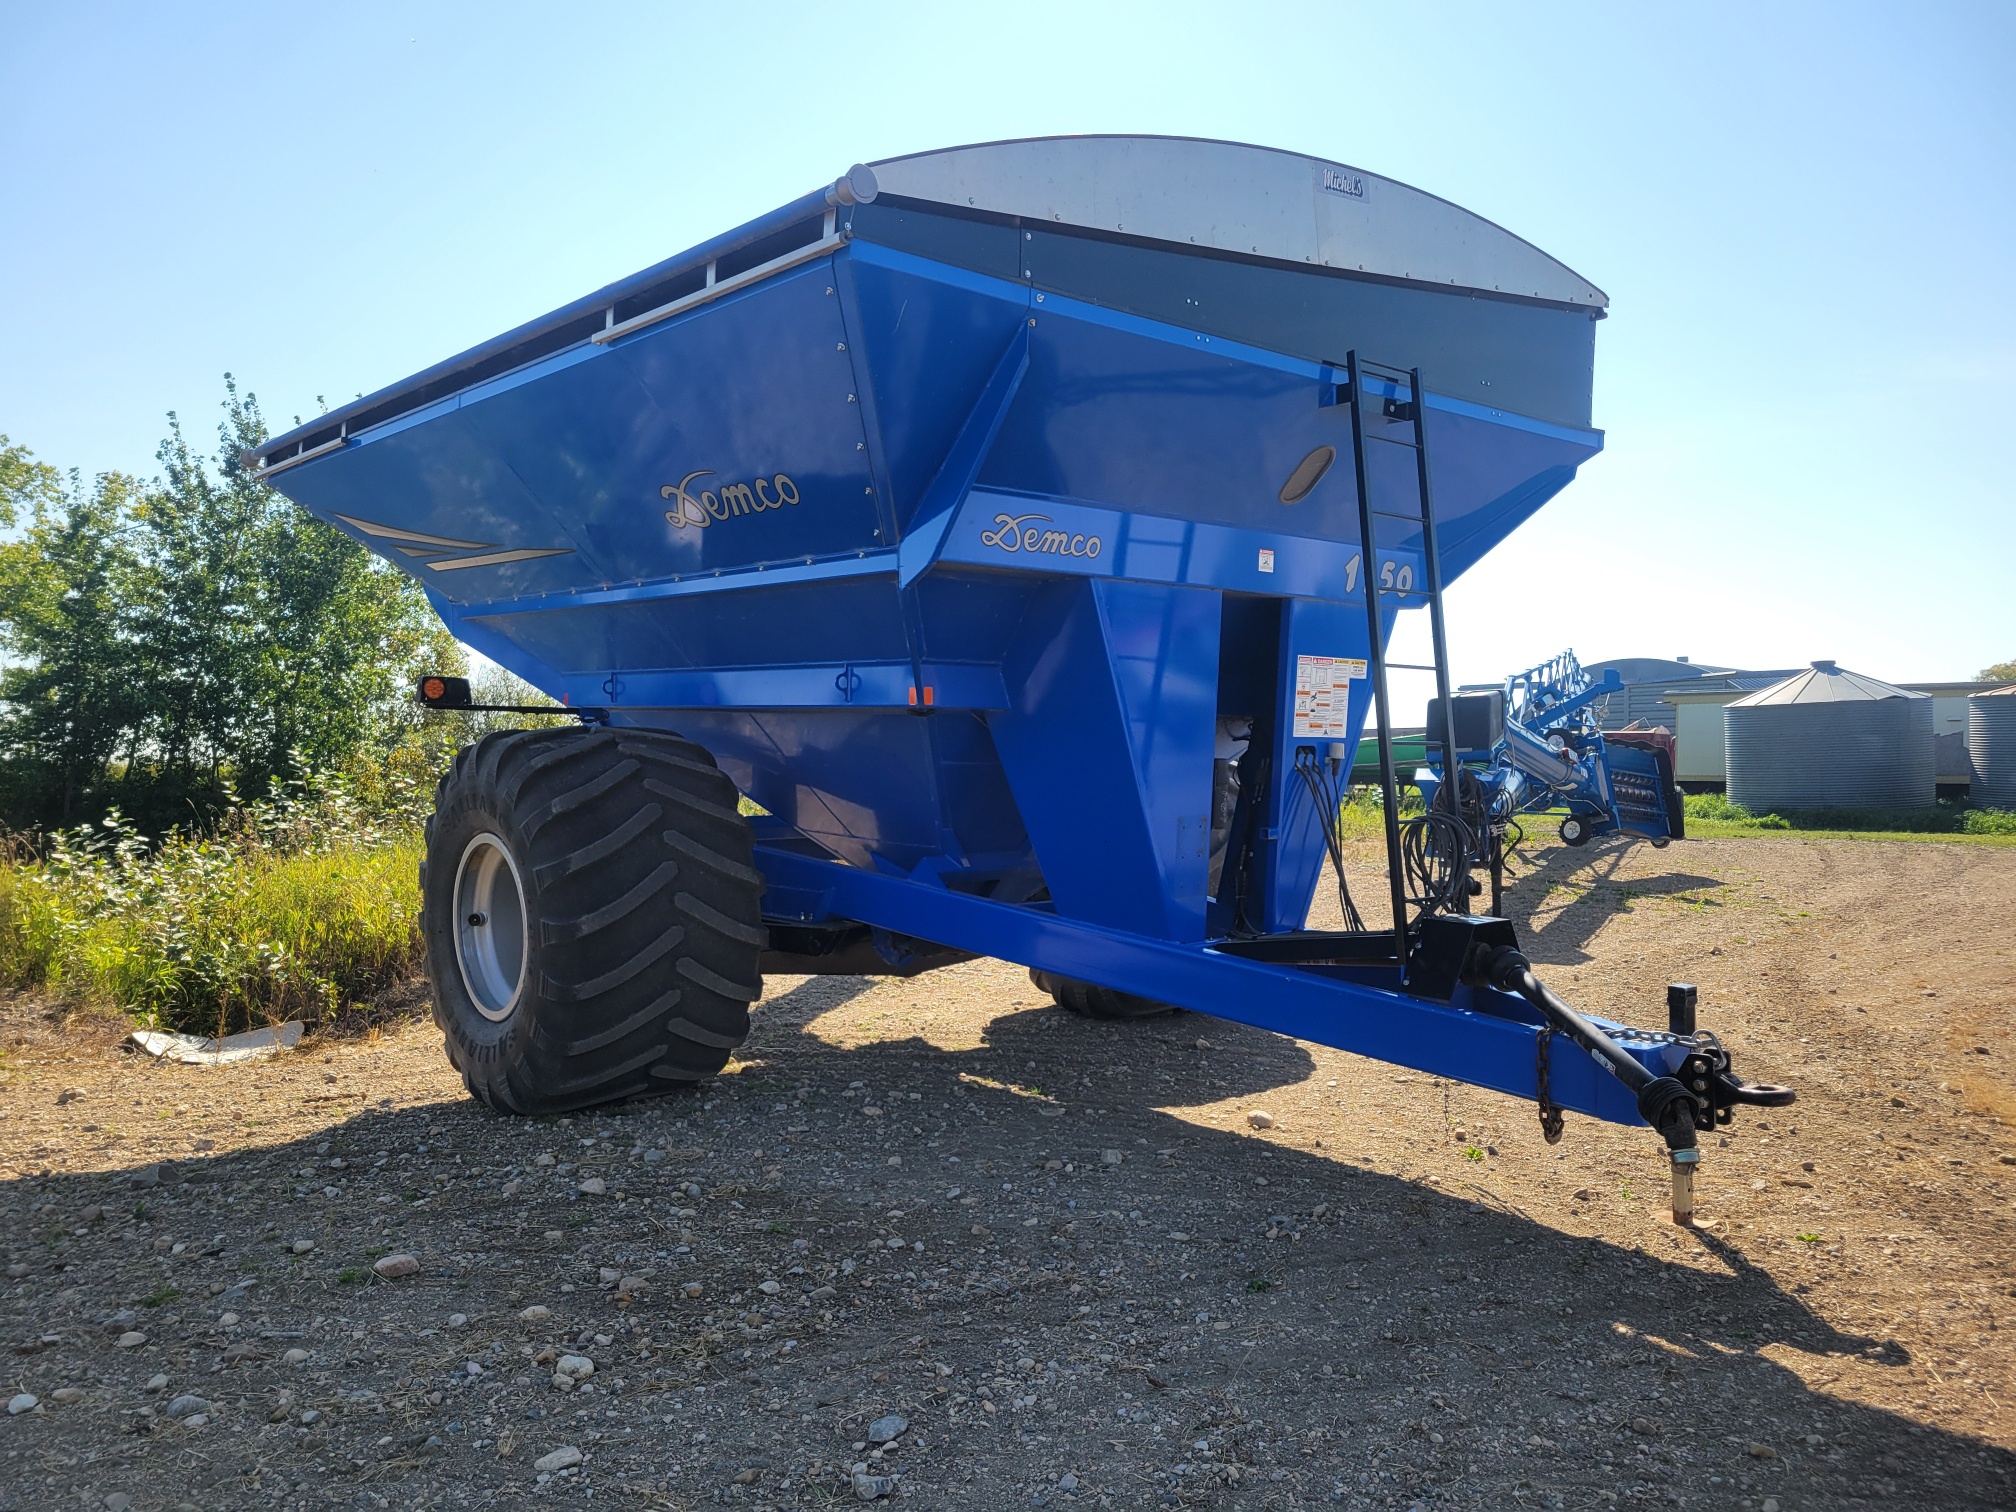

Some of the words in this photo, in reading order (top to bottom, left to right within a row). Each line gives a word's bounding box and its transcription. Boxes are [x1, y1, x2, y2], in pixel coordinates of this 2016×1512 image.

[1322, 168, 1364, 198] Michel's
[660, 470, 800, 528] Demco
[981, 513, 1102, 558] Demco
[1344, 552, 1413, 598] 150
